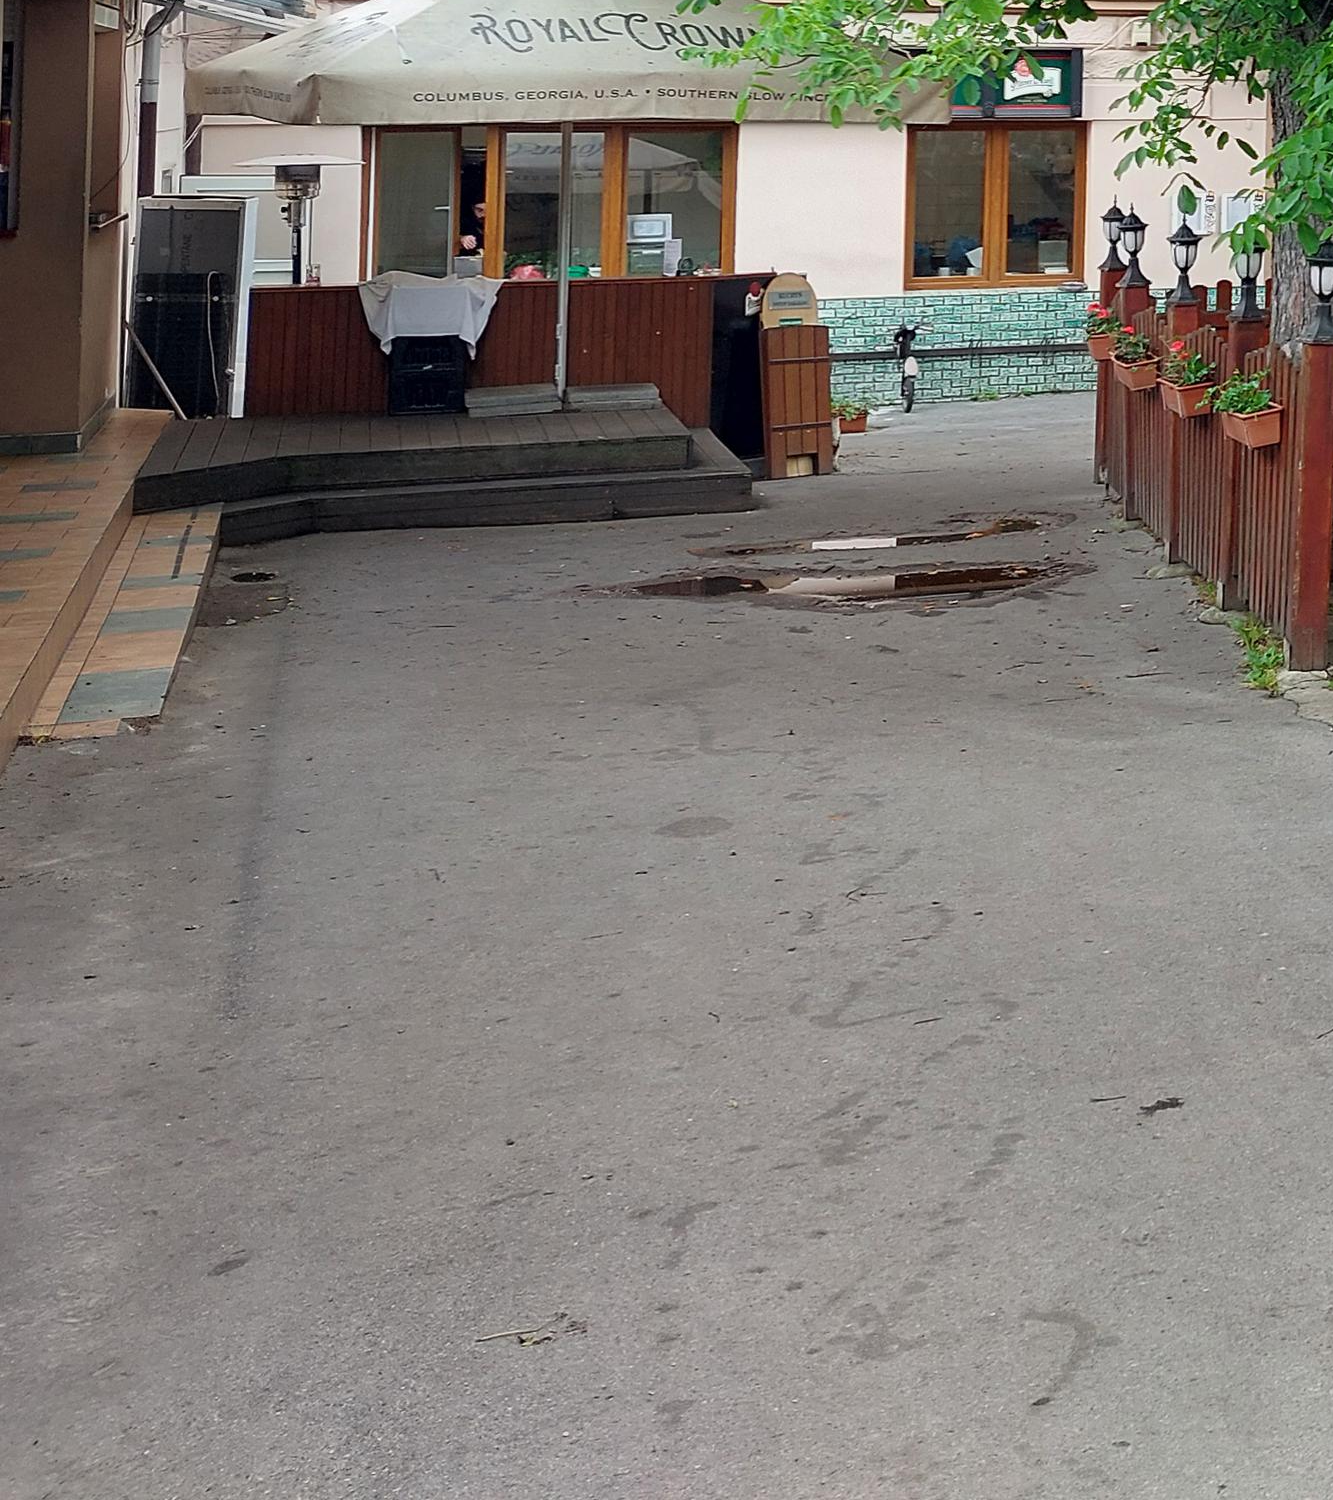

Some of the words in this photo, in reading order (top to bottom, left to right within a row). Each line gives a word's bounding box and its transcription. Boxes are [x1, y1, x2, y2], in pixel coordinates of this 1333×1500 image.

[469, 13, 610, 53] ROYAL
[593, 13, 758, 50] CROW
[657, 88, 738, 100] SOUTHERN
